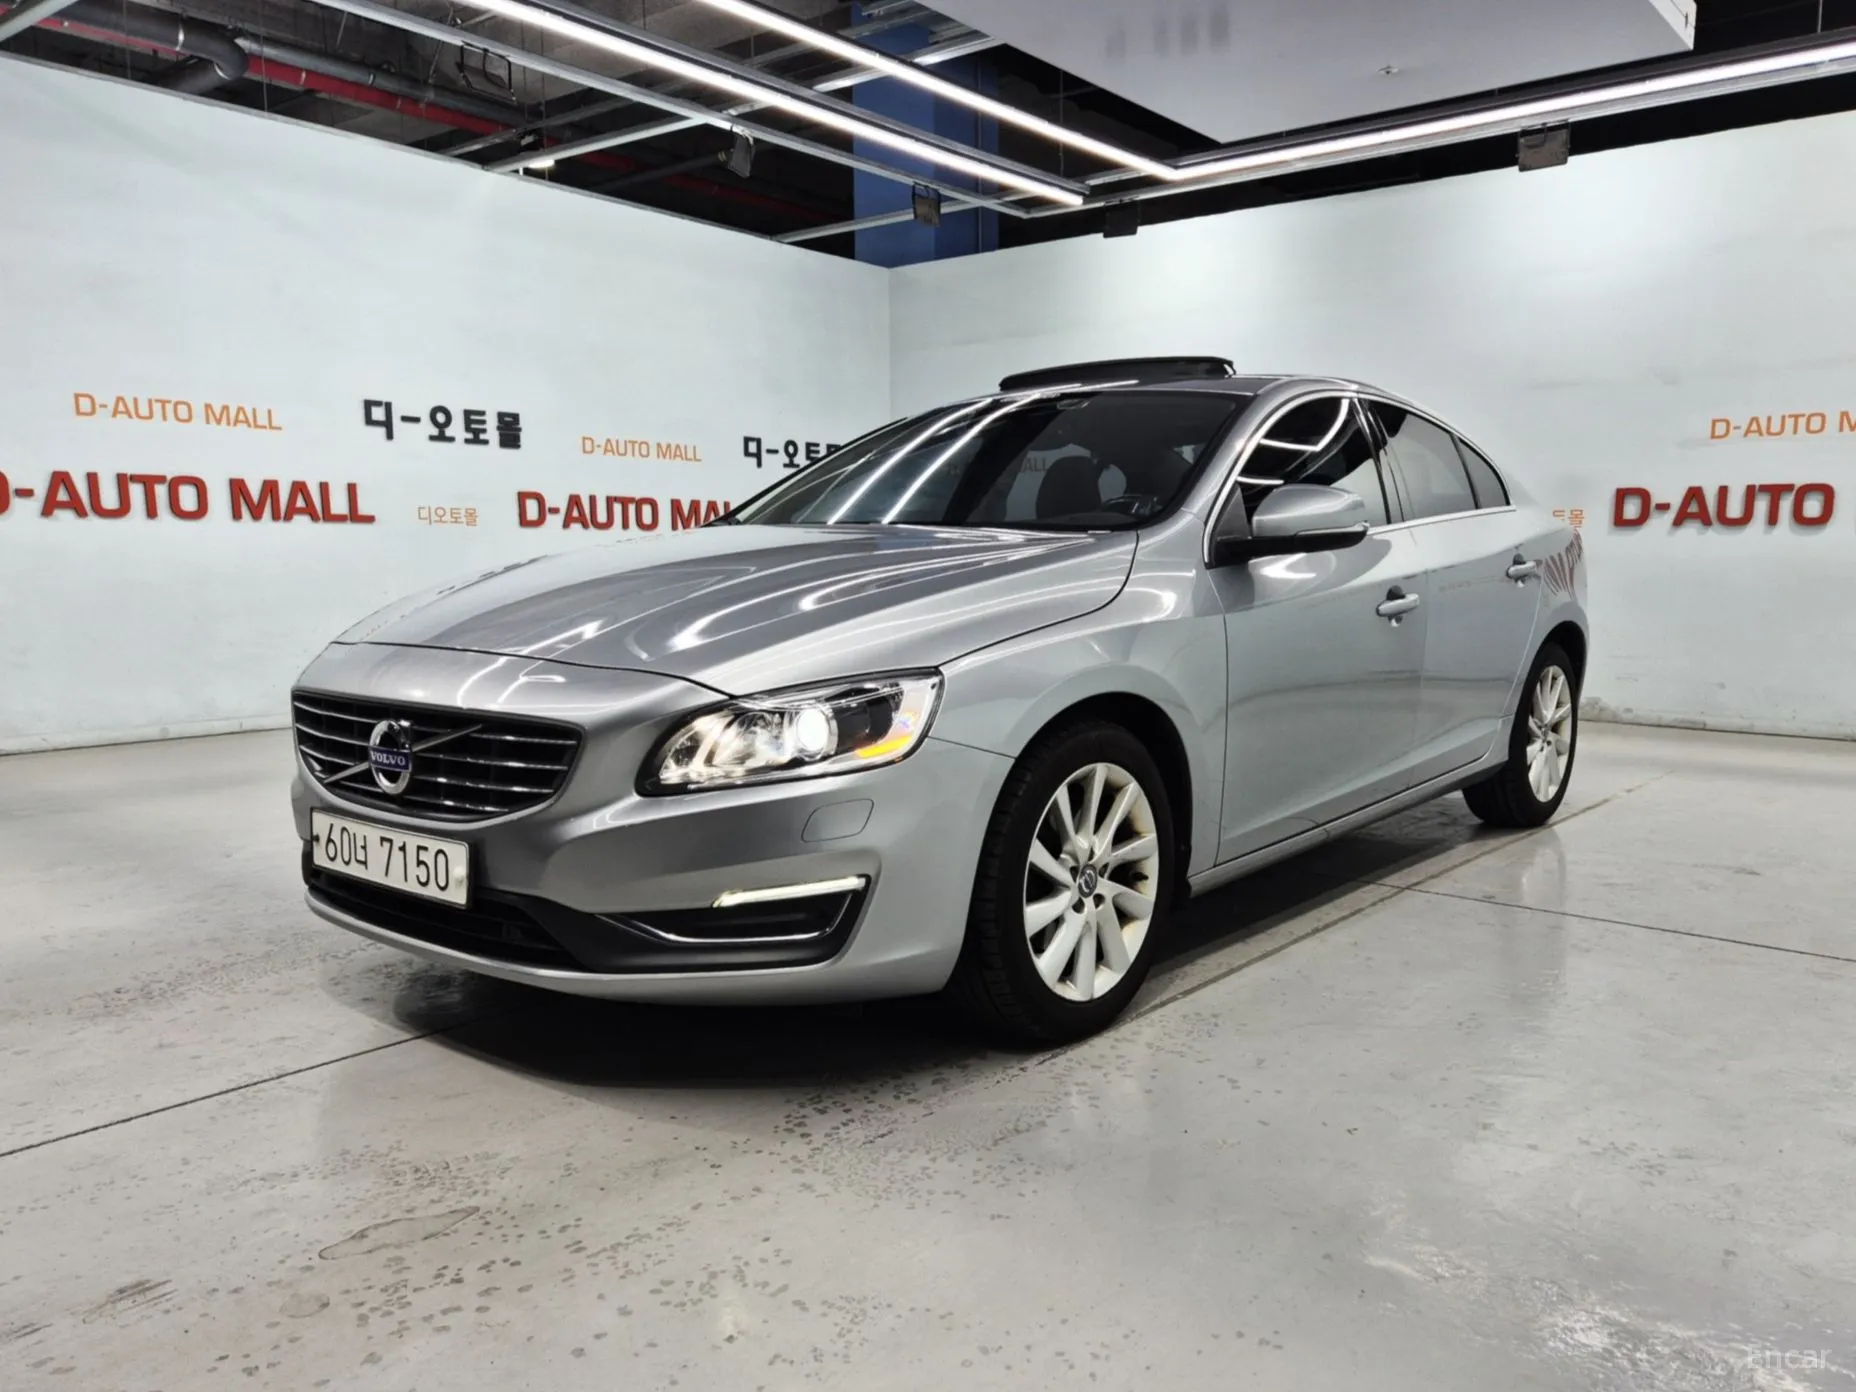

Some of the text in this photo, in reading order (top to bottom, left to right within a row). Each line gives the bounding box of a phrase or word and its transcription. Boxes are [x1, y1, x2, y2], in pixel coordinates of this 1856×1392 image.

[73, 391, 283, 432] D-AUTO MALL
[363, 399, 522, 450] 디-오토몰
[1710, 411, 1828, 441] D-AUTO
[581, 435, 703, 463] D-AUTO MALL
[0, 470, 376, 524] -AUTO MALL
[417, 505, 479, 527] 디오토몰
[517, 490, 660, 532] D-AUTO
[1613, 483, 1835, 529] D-AUTO
[370, 750, 406, 766] VOLVO
[379, 836, 450, 892] 7150
